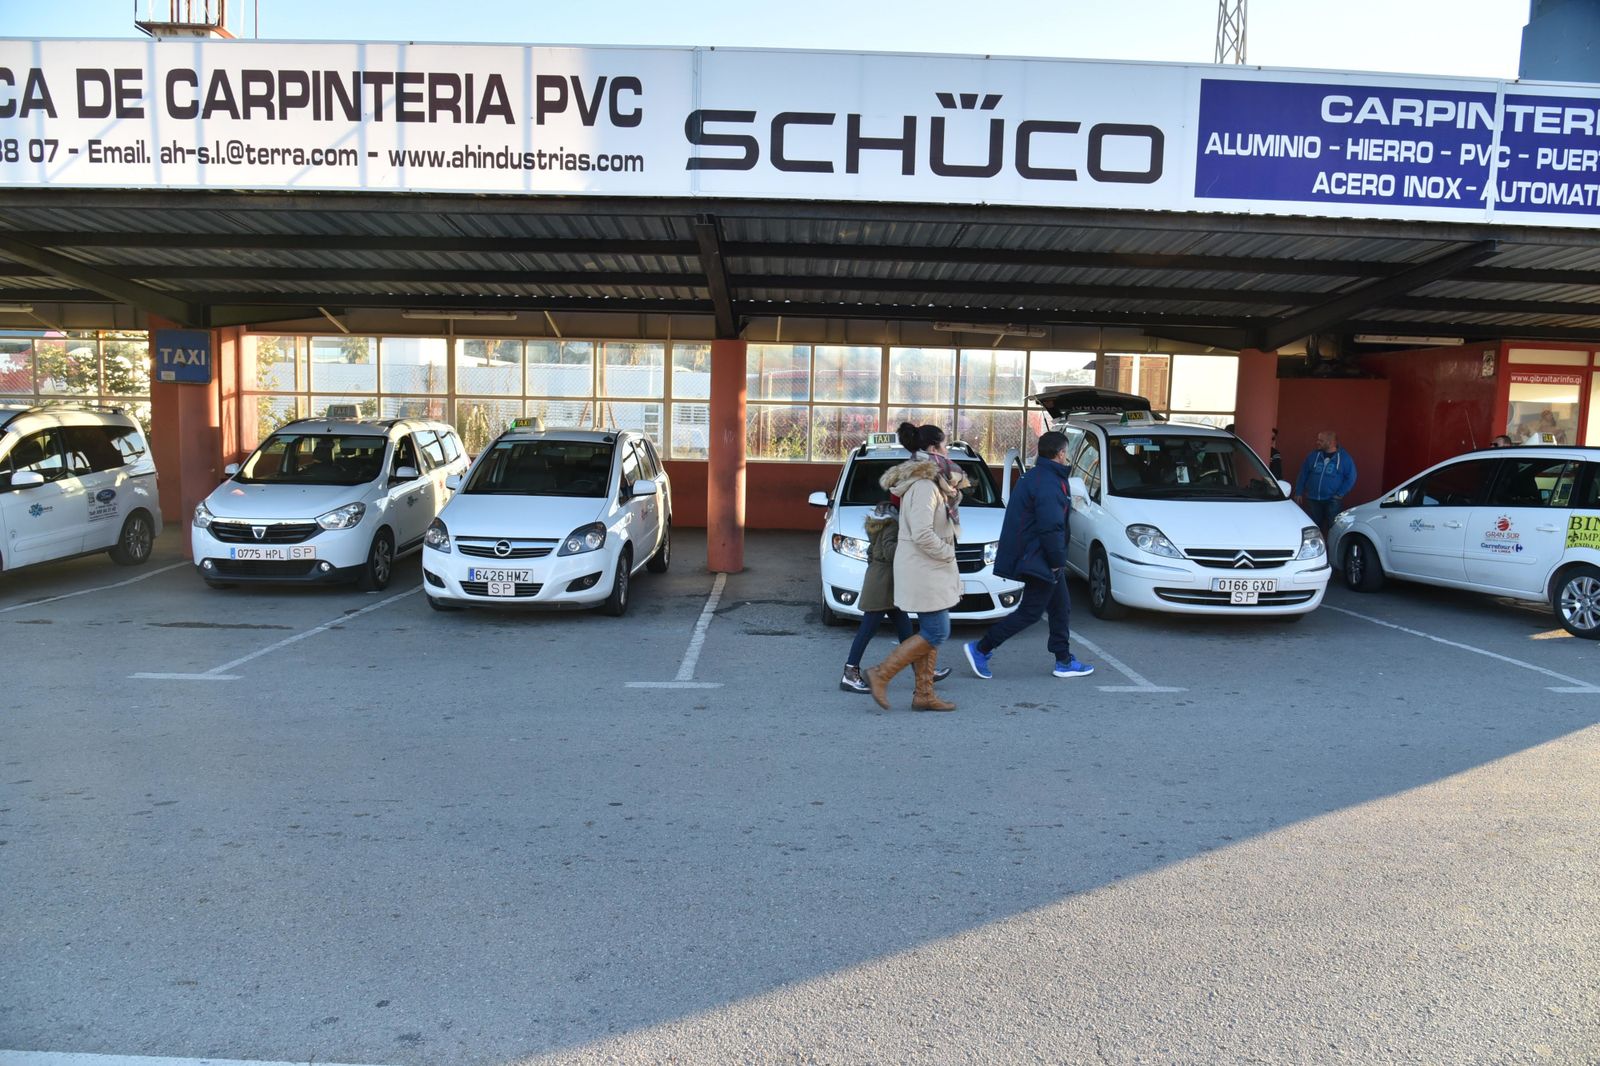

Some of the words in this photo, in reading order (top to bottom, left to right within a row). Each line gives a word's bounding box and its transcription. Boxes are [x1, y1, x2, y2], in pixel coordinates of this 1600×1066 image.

[76, 68, 145, 119] DE
[165, 68, 516, 125] CARPINTERIA
[536, 75, 643, 128] PVC
[0, 138, 20, 163] 8
[28, 138, 59, 163] 07
[88, 139, 151, 164] Email.
[160, 139, 358, 167] ah-s.l.@terra.com
[388, 144, 644, 172] www.ahindustrias.com
[1204, 131, 1322, 159] ALUMINIO
[1346, 138, 1434, 164] HIERRO
[1459, 143, 1511, 168] PVC
[1536, 147, 1600, 172] PUER
[1311, 171, 1396, 197] ACERO
[1403, 175, 1463, 200] INOX
[160, 348, 206, 366] TAXI
[1511, 374, 1582, 384] www.gibraltarinfo.gi
[874, 434, 890, 444] TAXI
[1507, 532, 1520, 540] SUR
[1579, 532, 1600, 542] IMP
[1480, 542, 1511, 550] Carrefour
[237, 548, 261, 559] 0775
[265, 549, 284, 560] HPL
[475, 570, 504, 581] 6426
[506, 571, 529, 582] HMZ
[1219, 580, 1248, 591] 0166
[1252, 580, 1274, 591] GXD
